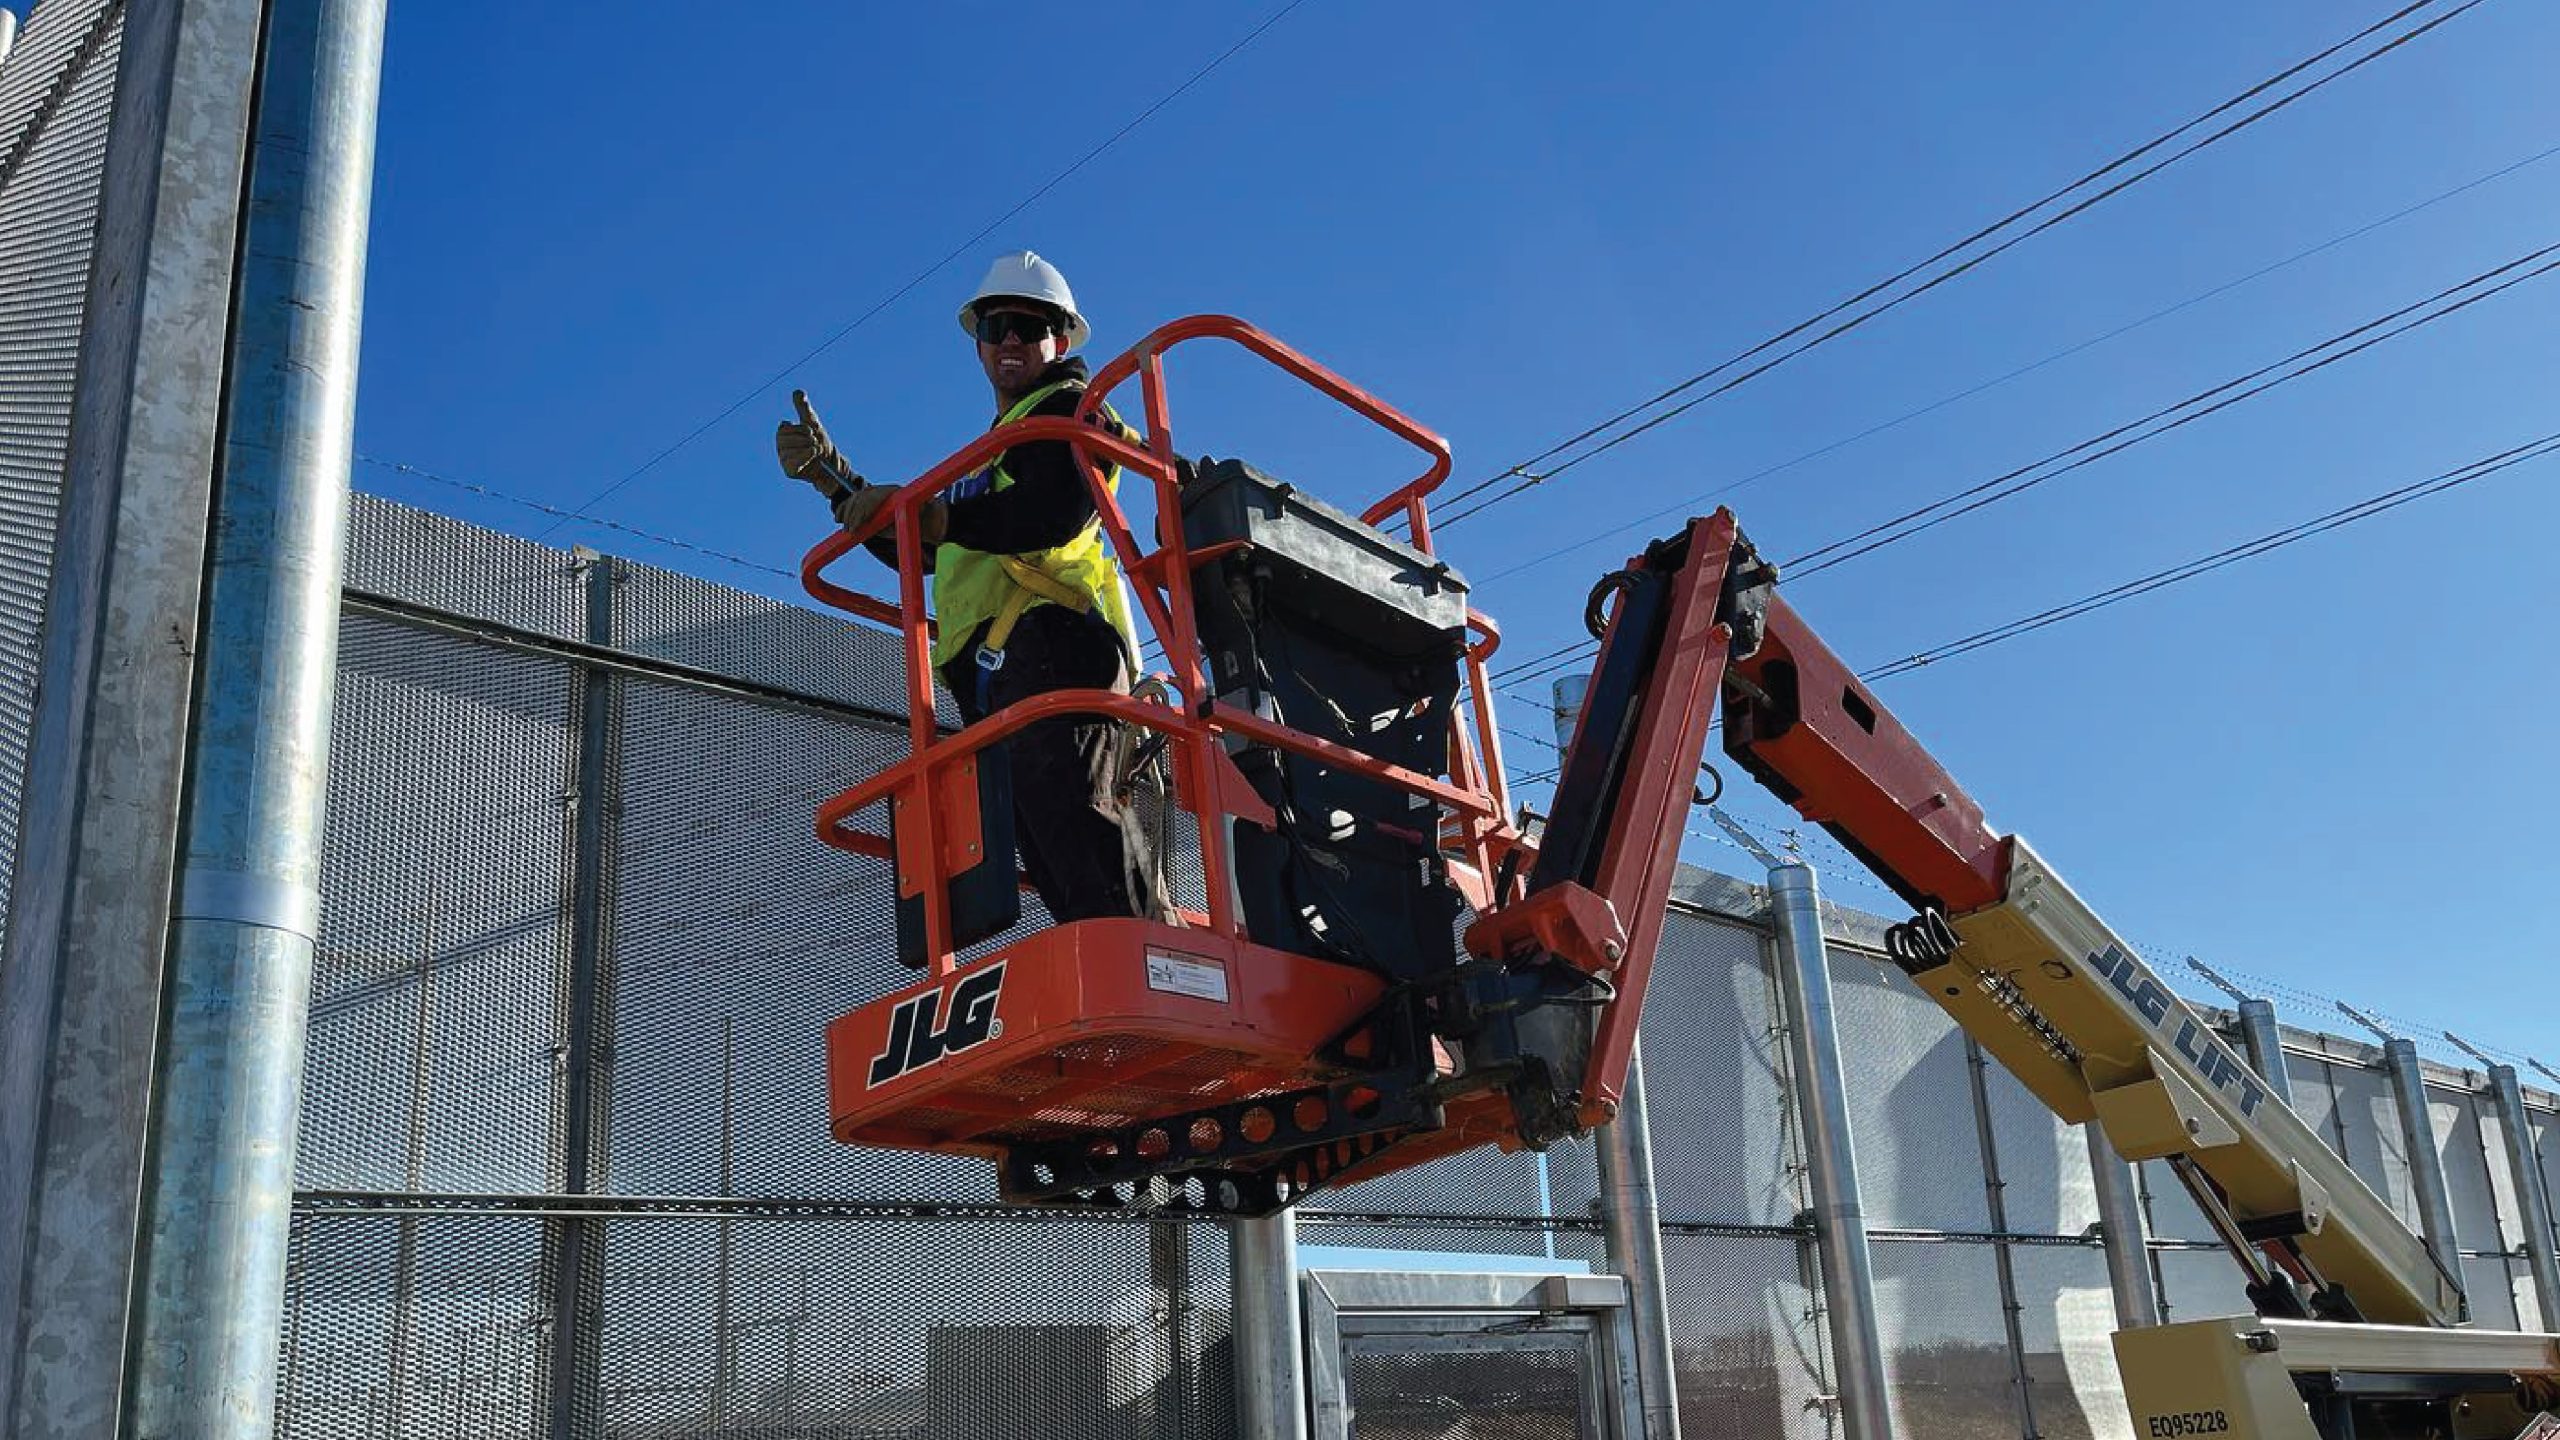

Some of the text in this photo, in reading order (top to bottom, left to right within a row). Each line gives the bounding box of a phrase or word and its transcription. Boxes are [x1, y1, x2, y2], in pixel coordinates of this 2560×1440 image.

[866, 959, 1008, 1090] JLG
[2086, 943, 2266, 1119] JLG LIFT
[2148, 1409, 2228, 1439] EQ95228
